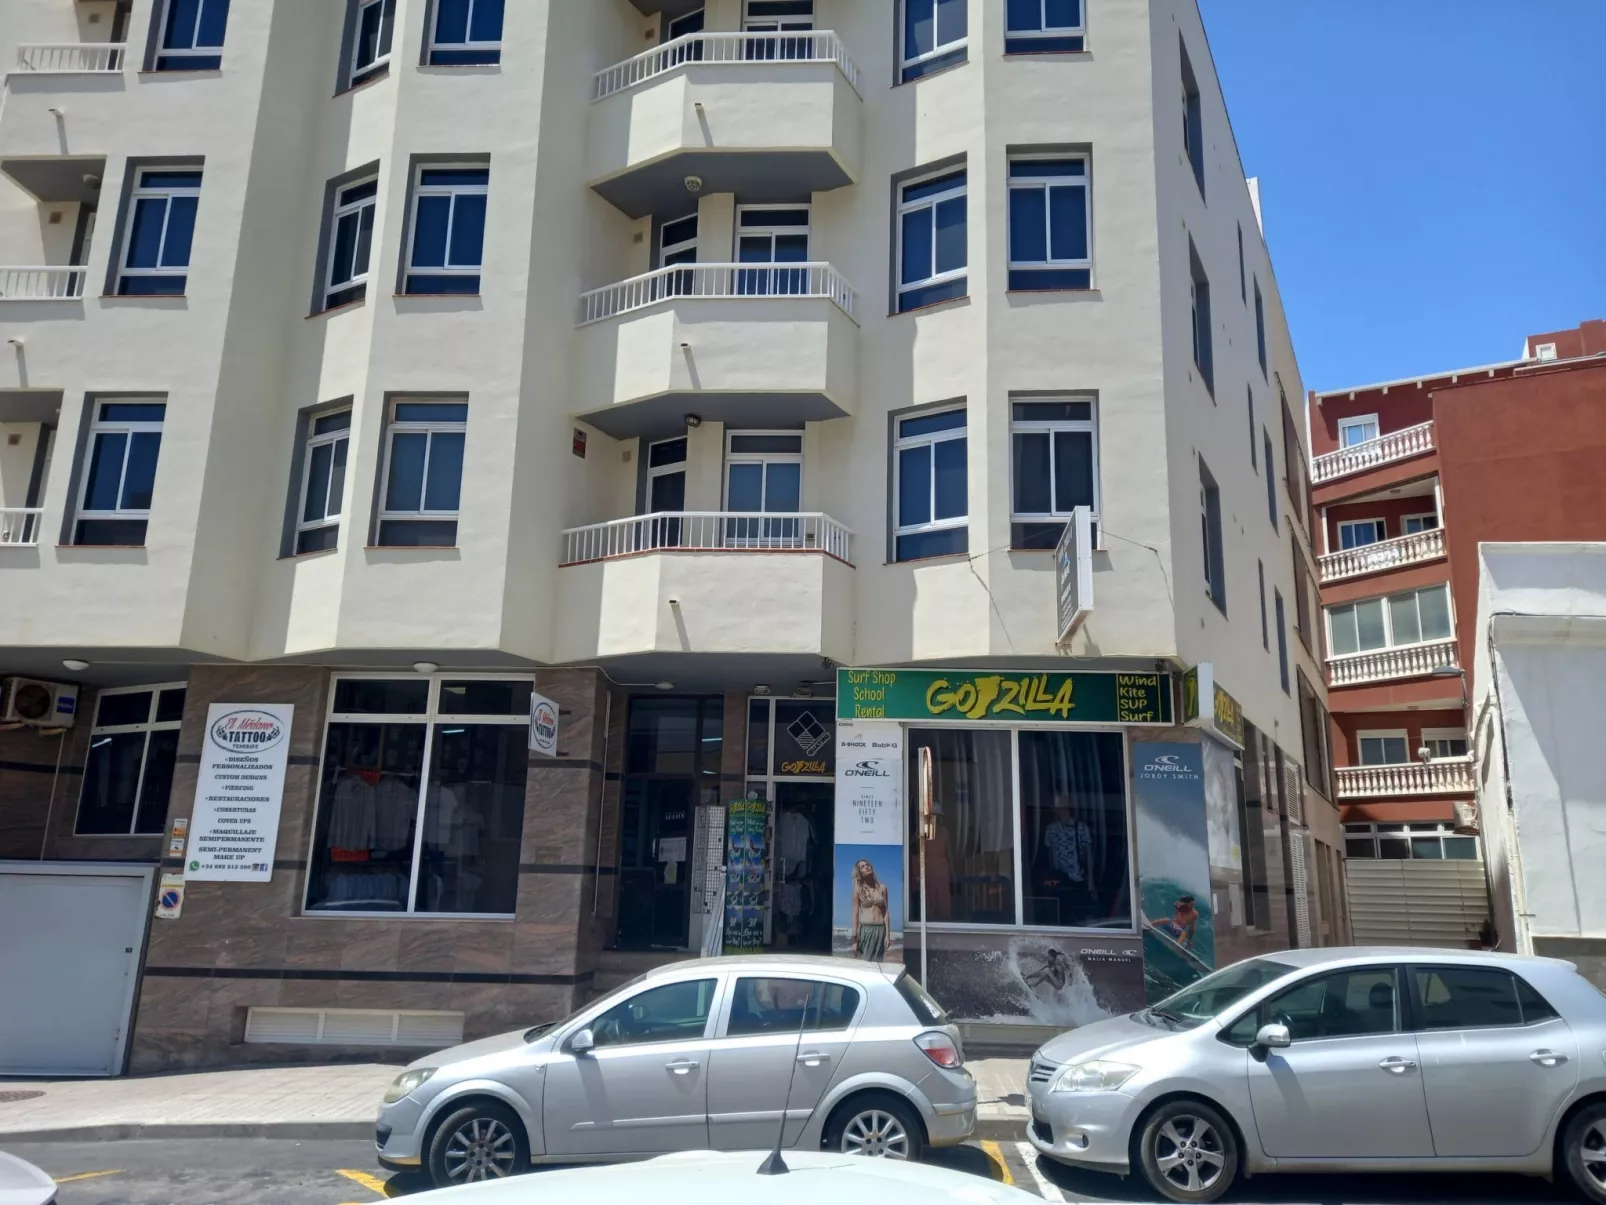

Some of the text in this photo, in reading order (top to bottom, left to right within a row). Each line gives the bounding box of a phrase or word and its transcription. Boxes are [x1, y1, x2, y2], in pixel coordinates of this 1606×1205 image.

[848, 670, 896, 688] Surf Shop
[1119, 676, 1157, 686] Wind
[853, 687, 885, 701] School
[1120, 687, 1146, 697] Kite
[1120, 699, 1147, 709] SUP
[855, 703, 885, 718] Rental
[1121, 710, 1154, 722] Surf
[229, 731, 266, 743] TATTOO
[852, 800, 883, 808] NINETEEN
